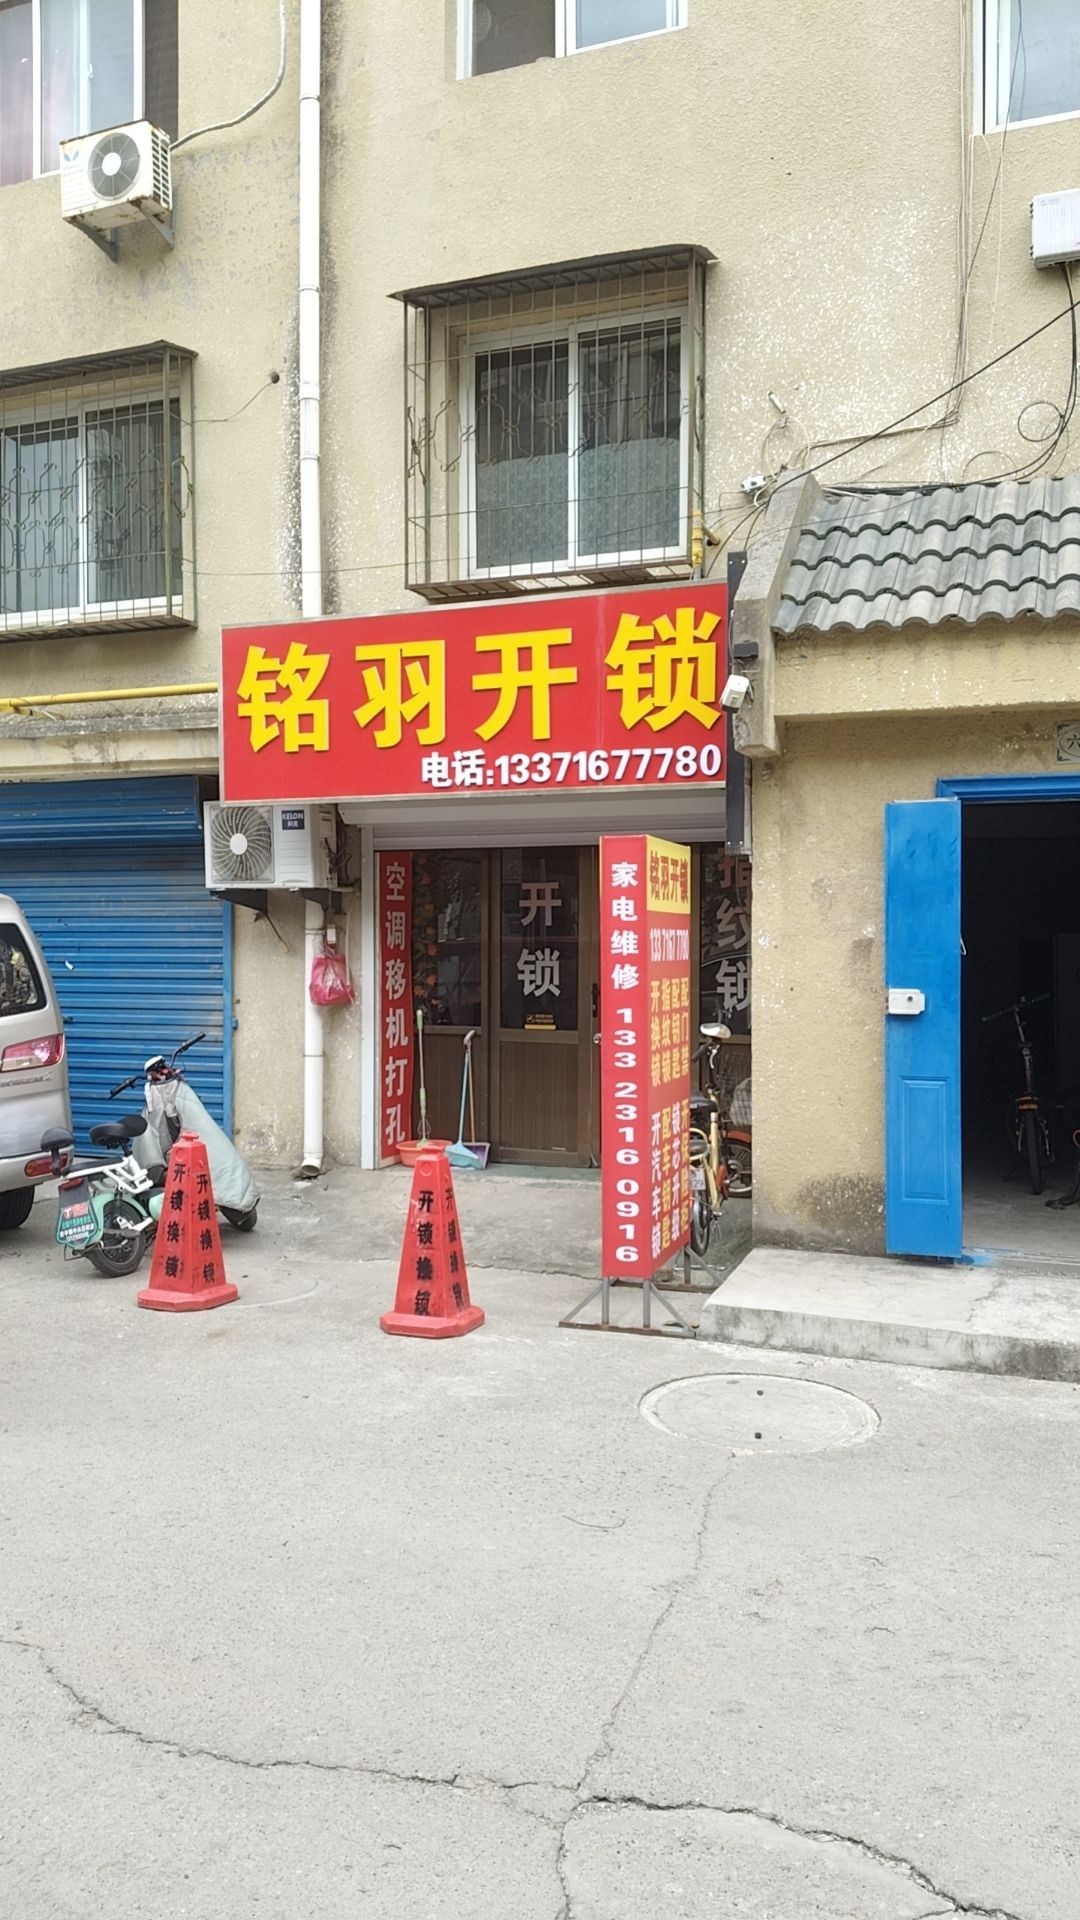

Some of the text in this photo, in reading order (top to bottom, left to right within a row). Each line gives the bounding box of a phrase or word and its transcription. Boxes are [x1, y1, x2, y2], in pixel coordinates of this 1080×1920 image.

[237, 607, 722, 752] 铭羽开锁
[421, 743, 722, 788] 电话:13371677780
[610, 861, 640, 990] 家电维修
[650, 850, 688, 904] 铭羽开锁
[516, 881, 562, 998] 开锁
[385, 862, 408, 1146] 空调移机打孔
[164, 1163, 186, 1278] 开锁换锁
[196, 1173, 215, 1284] 开锁换锁
